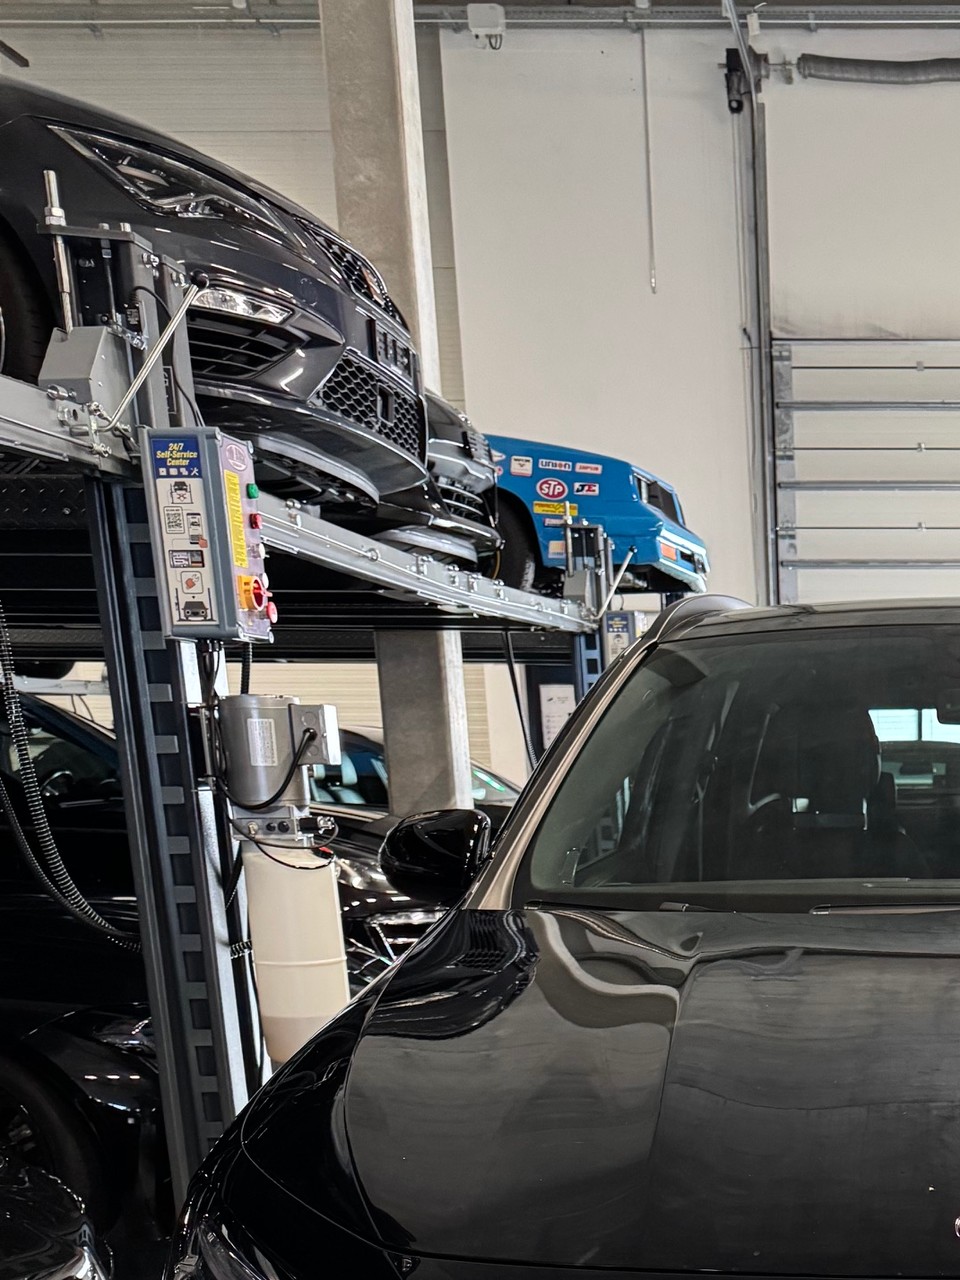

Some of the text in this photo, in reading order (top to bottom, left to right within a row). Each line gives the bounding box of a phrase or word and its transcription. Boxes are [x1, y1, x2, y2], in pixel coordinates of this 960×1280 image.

[168, 443, 184, 451] 24/7
[156, 450, 198, 459] Self-Service
[167, 458, 190, 466] Center
[541, 480, 564, 496] STP
[576, 484, 597, 493] JE
